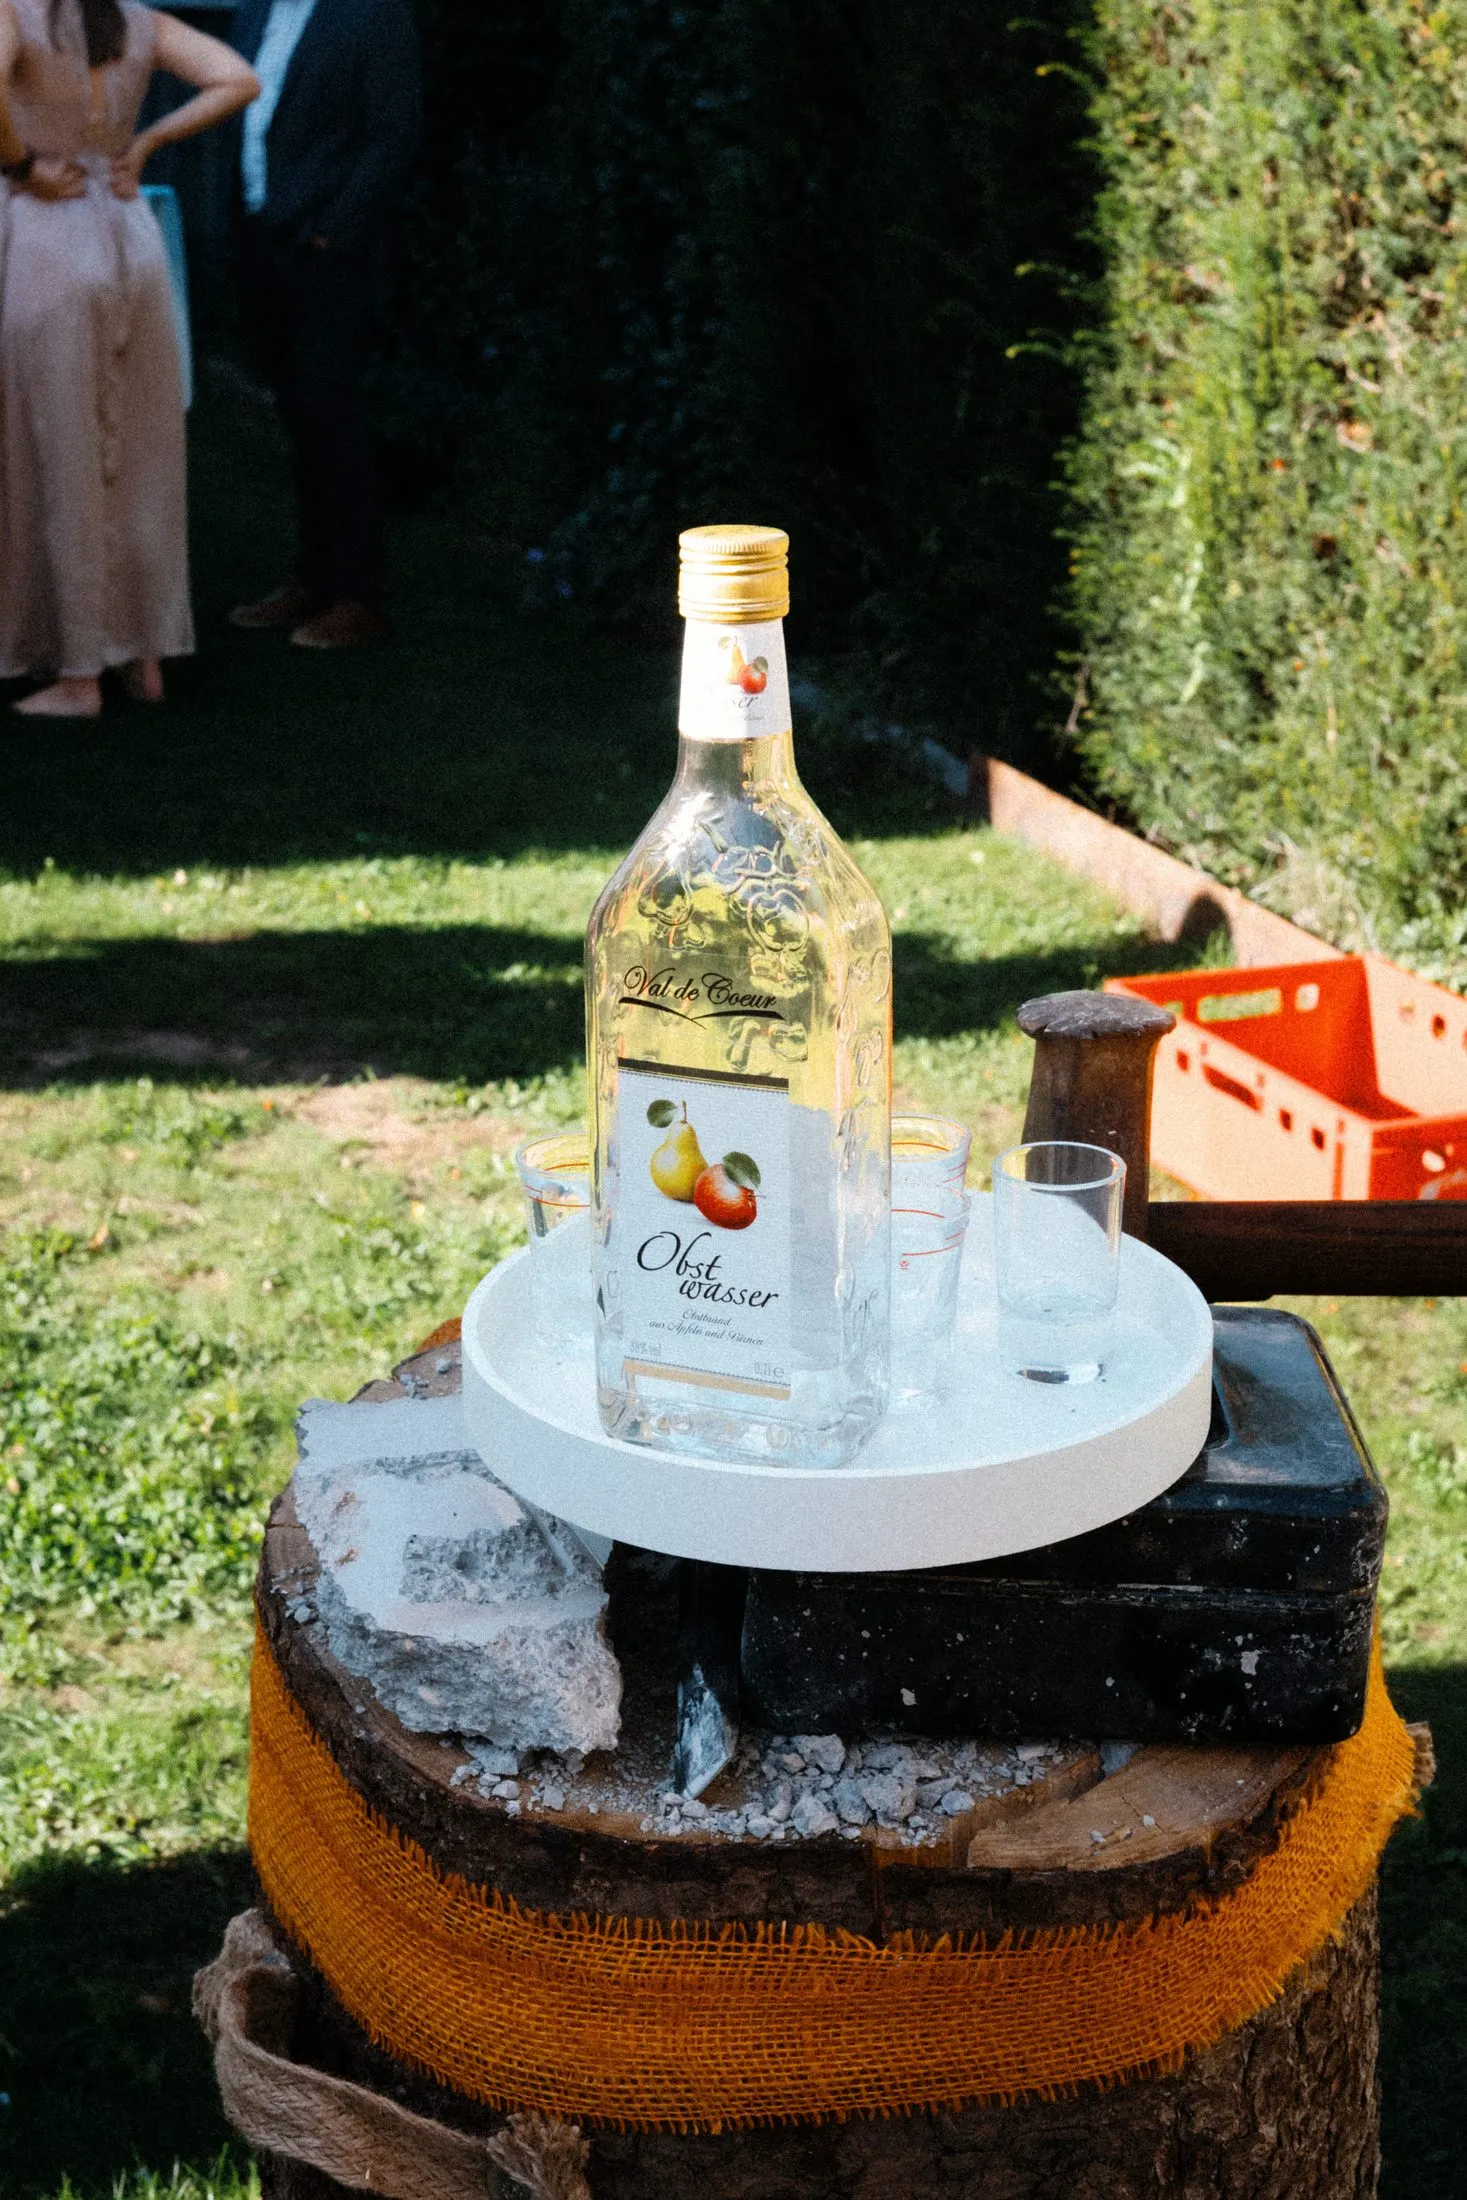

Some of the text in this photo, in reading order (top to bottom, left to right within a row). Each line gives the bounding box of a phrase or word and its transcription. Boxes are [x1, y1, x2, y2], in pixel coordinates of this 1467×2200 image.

[624, 965, 778, 1010] Val de Coeur
[636, 1230, 723, 1282] Obst
[678, 1278, 780, 1308] wasser
[704, 1329, 726, 1340] und
